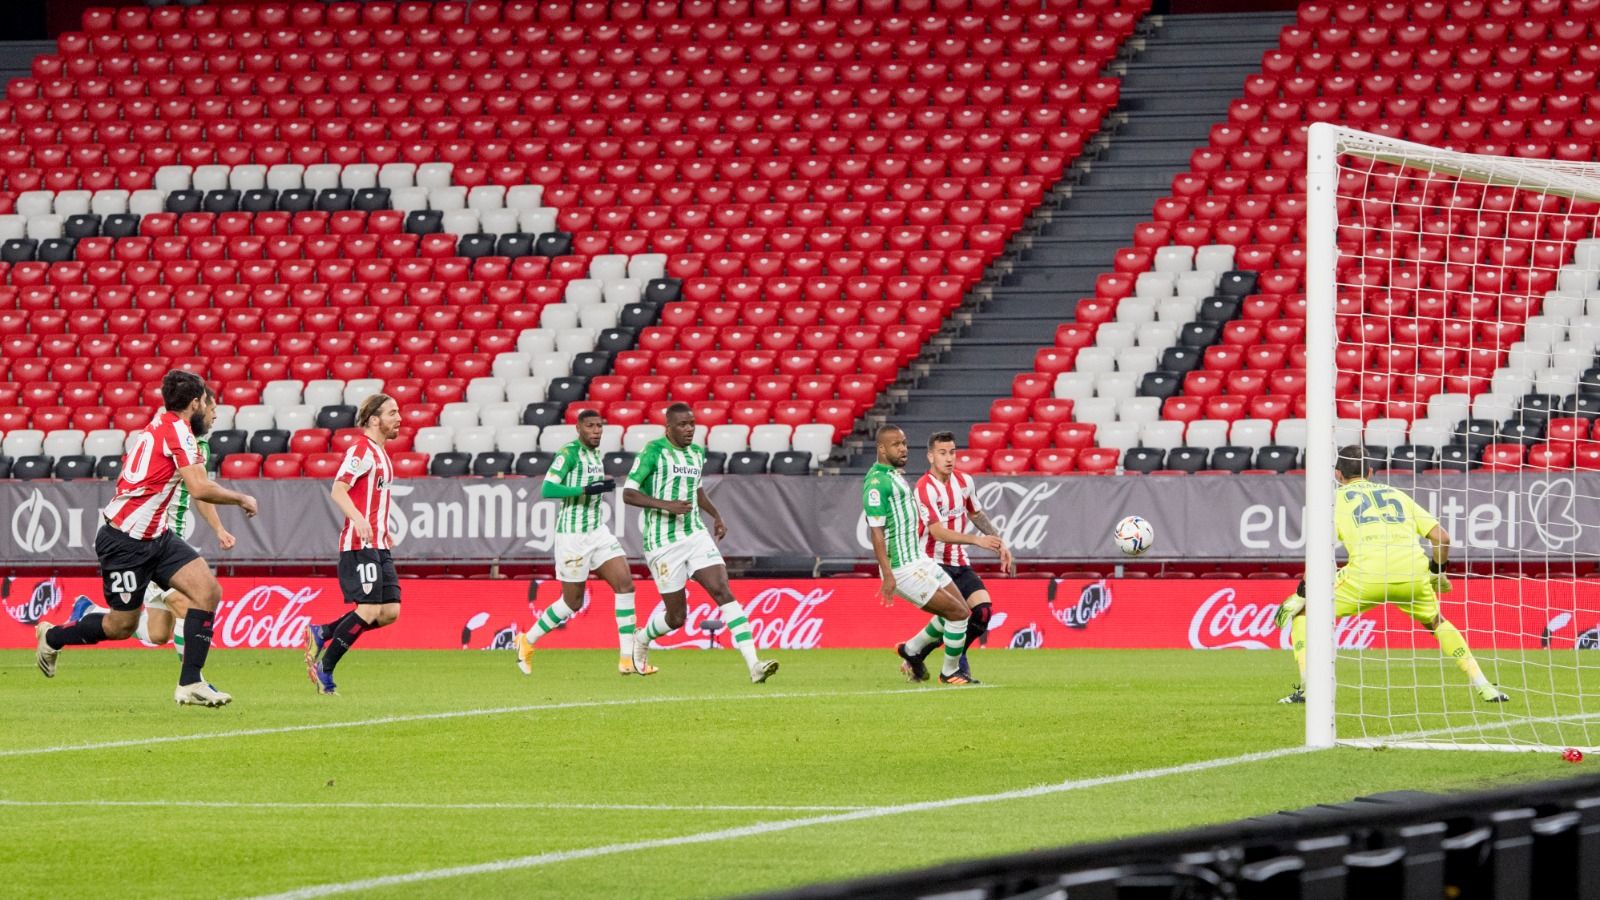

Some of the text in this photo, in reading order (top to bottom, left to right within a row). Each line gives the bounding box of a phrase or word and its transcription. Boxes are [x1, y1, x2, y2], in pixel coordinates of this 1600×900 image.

[673, 464, 701, 477] betway
[1344, 489, 1406, 528] 25
[109, 570, 138, 593] 20
[356, 562, 378, 583] 10
